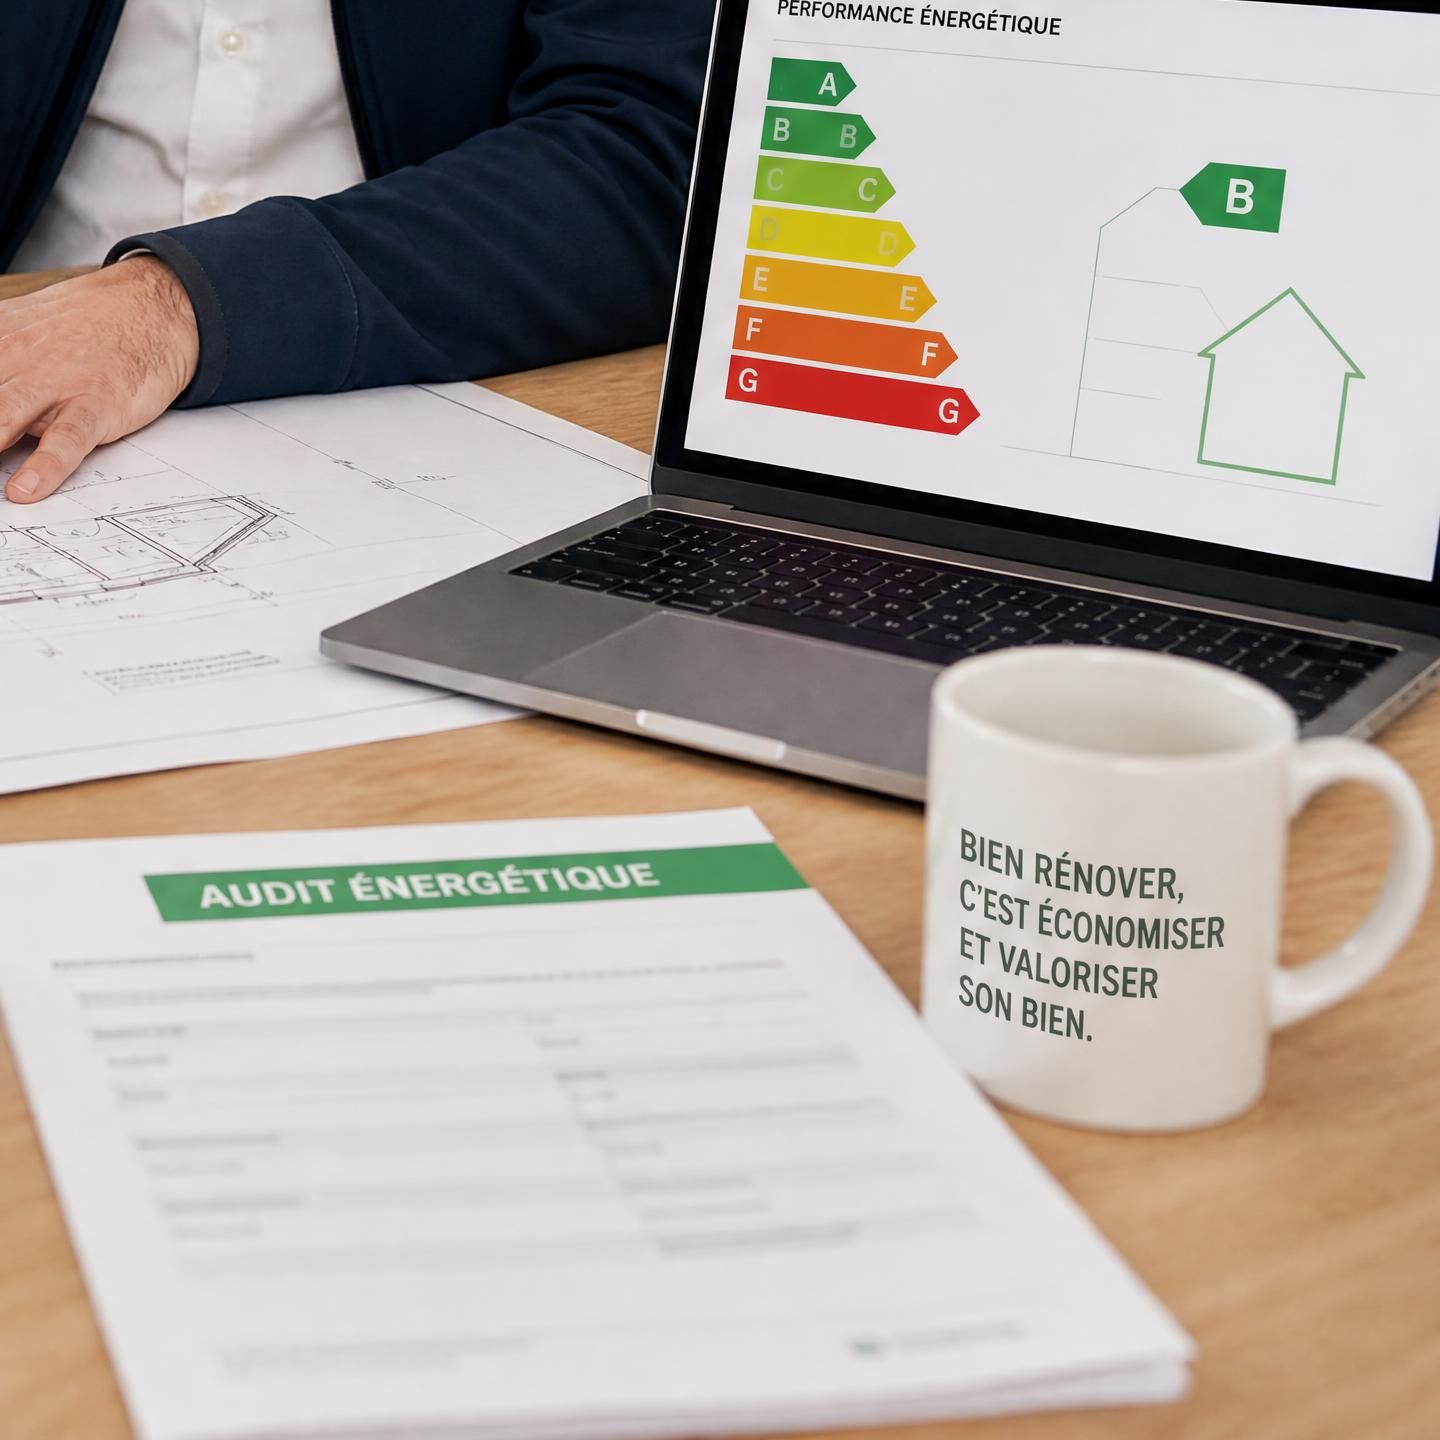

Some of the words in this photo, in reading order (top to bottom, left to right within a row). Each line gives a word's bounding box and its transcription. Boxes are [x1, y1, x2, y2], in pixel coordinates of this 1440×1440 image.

[920, 4, 1062, 36] ÉNERGÉTIQUE
[818, 72, 838, 97] A
[773, 117, 790, 142] B
[840, 124, 857, 149] B
[766, 168, 784, 192] C
[859, 178, 877, 202] C
[1225, 178, 1254, 214] B
[753, 267, 770, 292] E
[900, 286, 917, 311] E
[745, 317, 763, 341] F
[921, 342, 939, 366] F
[738, 368, 758, 393] G
[938, 398, 959, 424] G
[961, 828, 1023, 880] BIEN
[1035, 851, 1184, 904] RÉNOVER,
[199, 878, 335, 910] AUDIT
[349, 862, 660, 903] ÉNERGÉTIQUE
[960, 879, 1029, 929] C’EST
[1038, 898, 1225, 950] ÉCONOMISER
[960, 926, 990, 965] ET
[999, 941, 1158, 999] VALORISER
[959, 975, 1011, 1021] SON
[1022, 996, 1092, 1042] BIEN.
